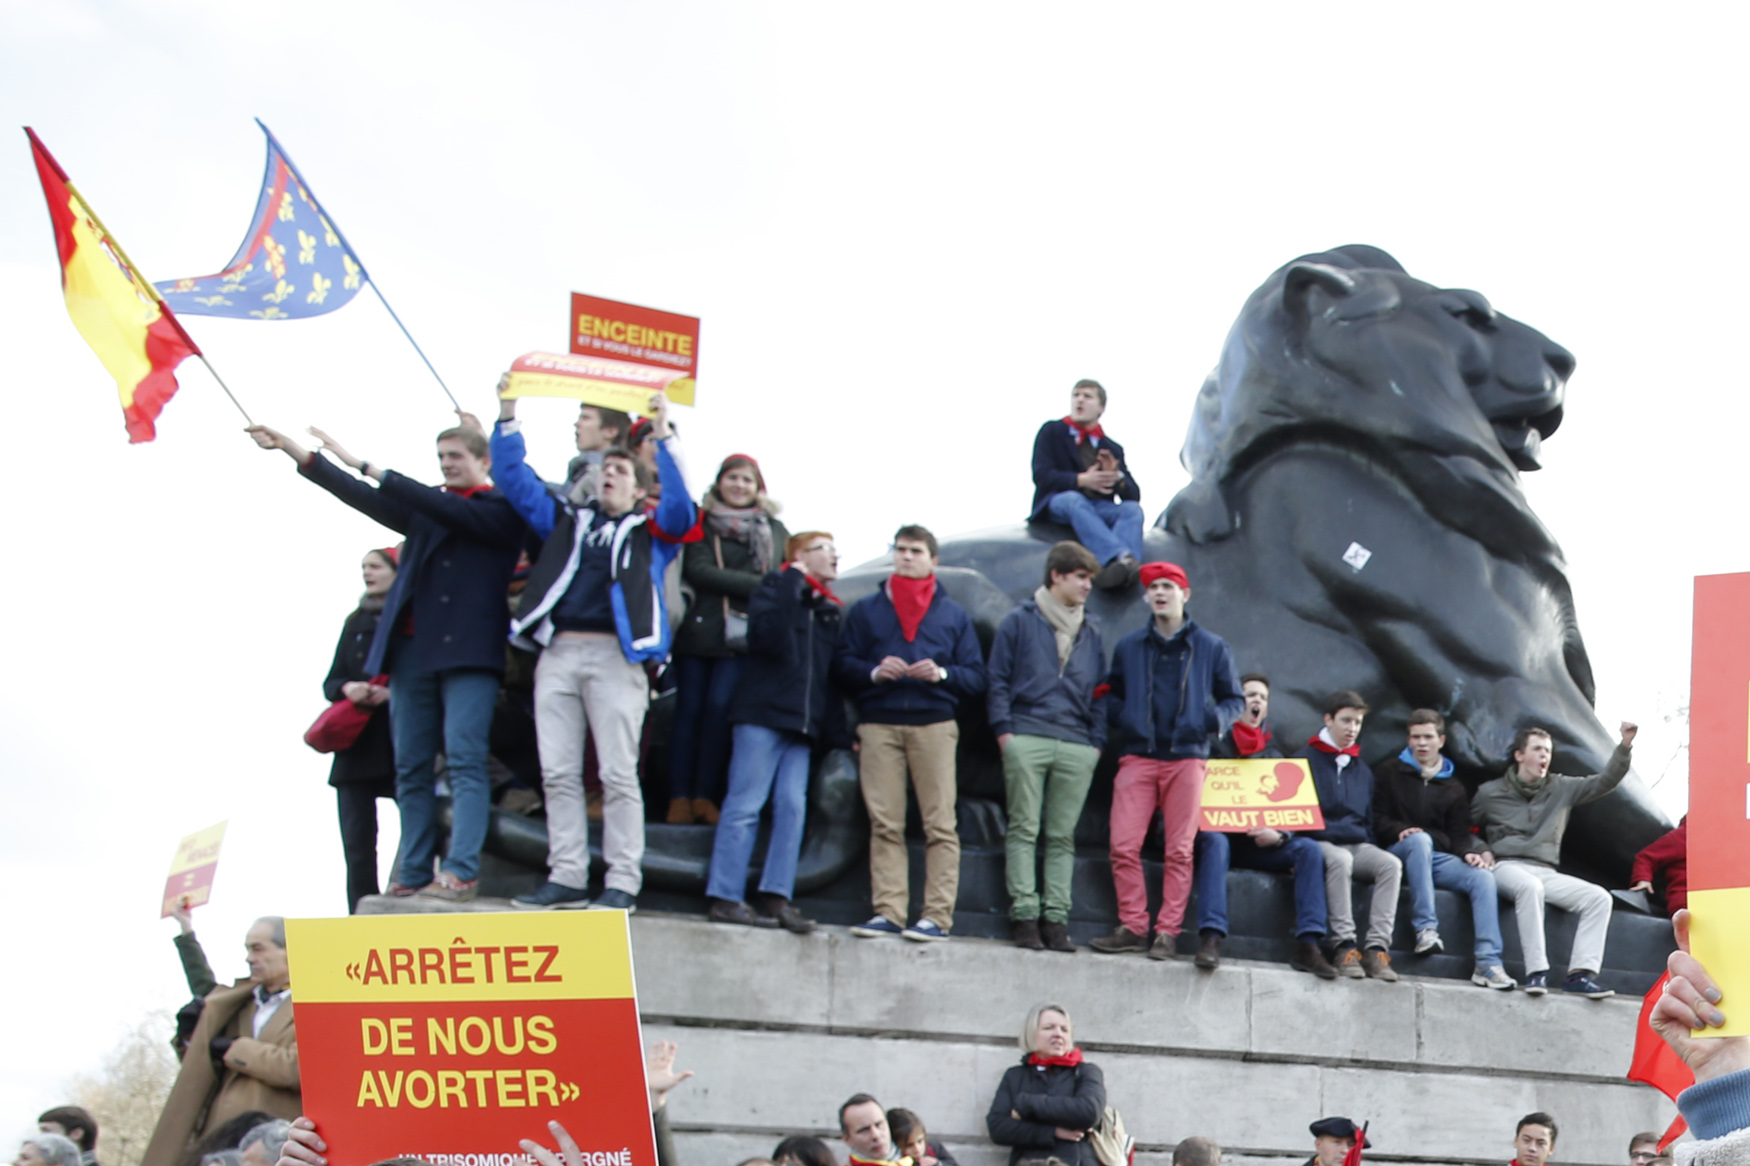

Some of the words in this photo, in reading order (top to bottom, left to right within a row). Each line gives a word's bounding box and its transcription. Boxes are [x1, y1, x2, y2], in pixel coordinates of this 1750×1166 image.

[578, 313, 693, 357] ENCEINTE
[1207, 766, 1240, 776] ARCE
[1204, 811, 1260, 827] VAUT
[1263, 809, 1314, 826] BIEN
[1232, 795, 1248, 805] LE
[346, 937, 562, 985] «ARRÊTEZ
[361, 1017, 415, 1056] DE
[427, 1015, 558, 1055] NOUS
[356, 1069, 580, 1109] AVORTER»
